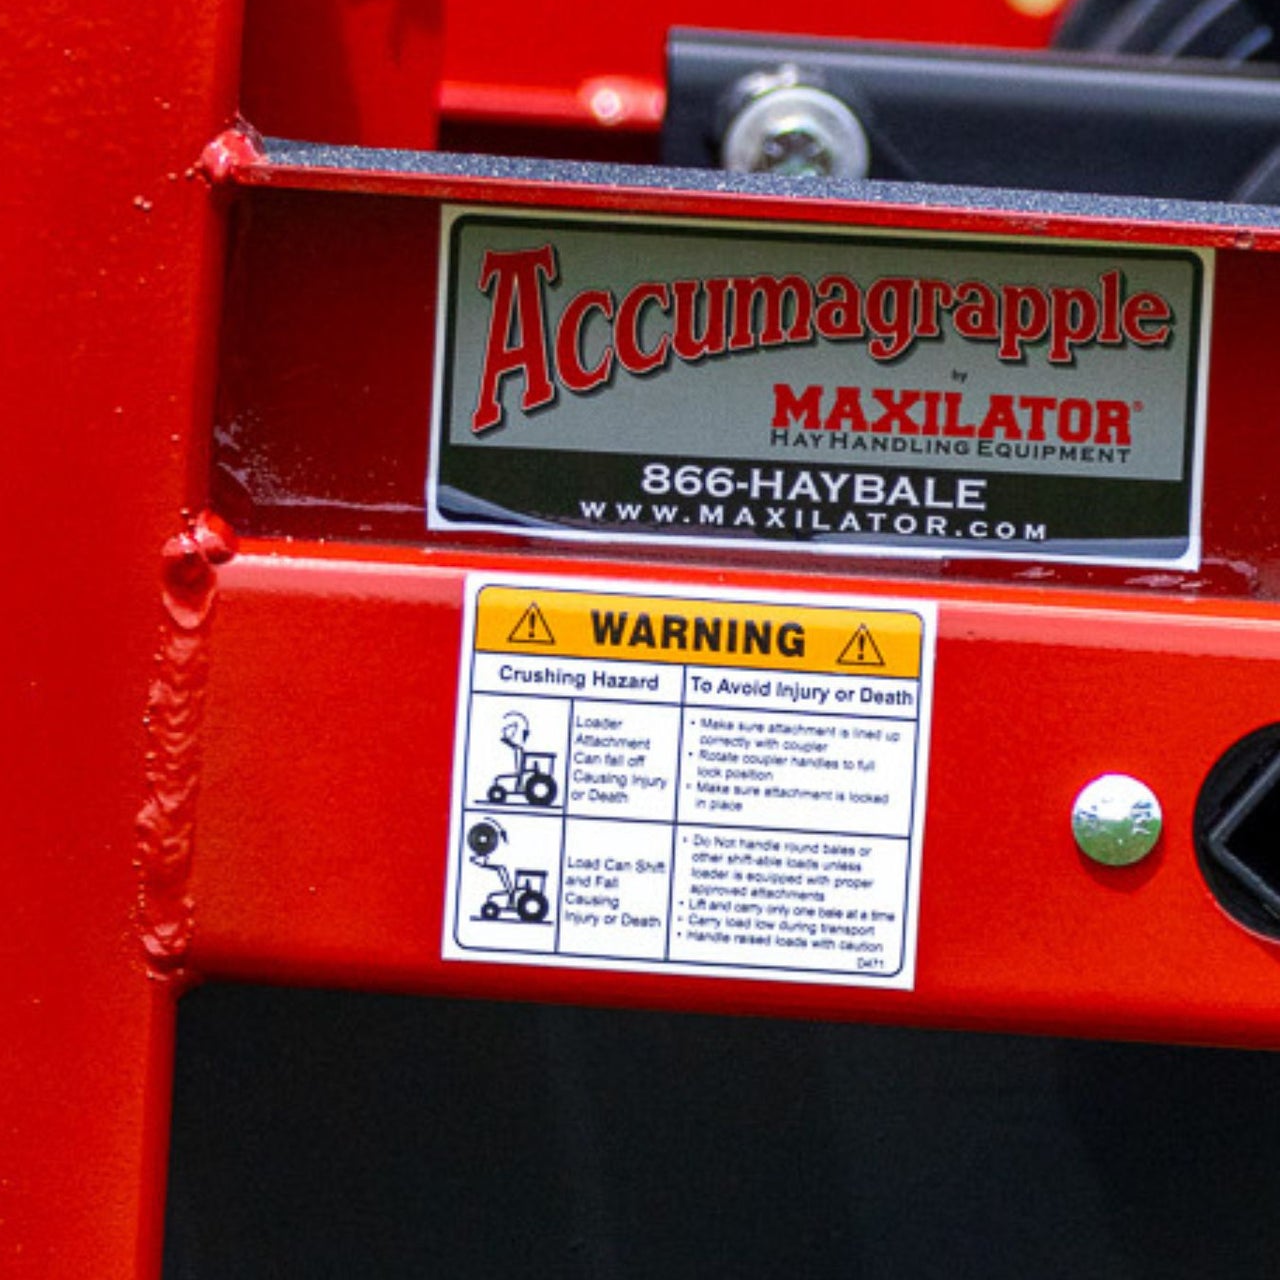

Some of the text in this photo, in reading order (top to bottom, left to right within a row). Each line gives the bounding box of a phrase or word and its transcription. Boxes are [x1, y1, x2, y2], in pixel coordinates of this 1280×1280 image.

[471, 244, 1173, 434] Accumagrapple
[952, 369, 969, 384] by
[770, 429, 1131, 464] HAY HANDLING EQUIPMENT
[641, 465, 987, 511] 866-HAYBALE
[589, 609, 807, 658] WARNING
[499, 664, 659, 692] Crushing Hazard
[690, 676, 913, 706] To Avoid Injury or Death
[576, 715, 622, 730] Loader
[574, 733, 650, 750] Attachment
[574, 751, 645, 767] Can fall off
[572, 769, 668, 790] Causing Injury
[571, 787, 628, 804] or Death
[567, 855, 665, 874] Load Can Shift
[565, 874, 619, 888] and Fall
[565, 892, 619, 910] Causing
[564, 910, 661, 927] Injury or Death
